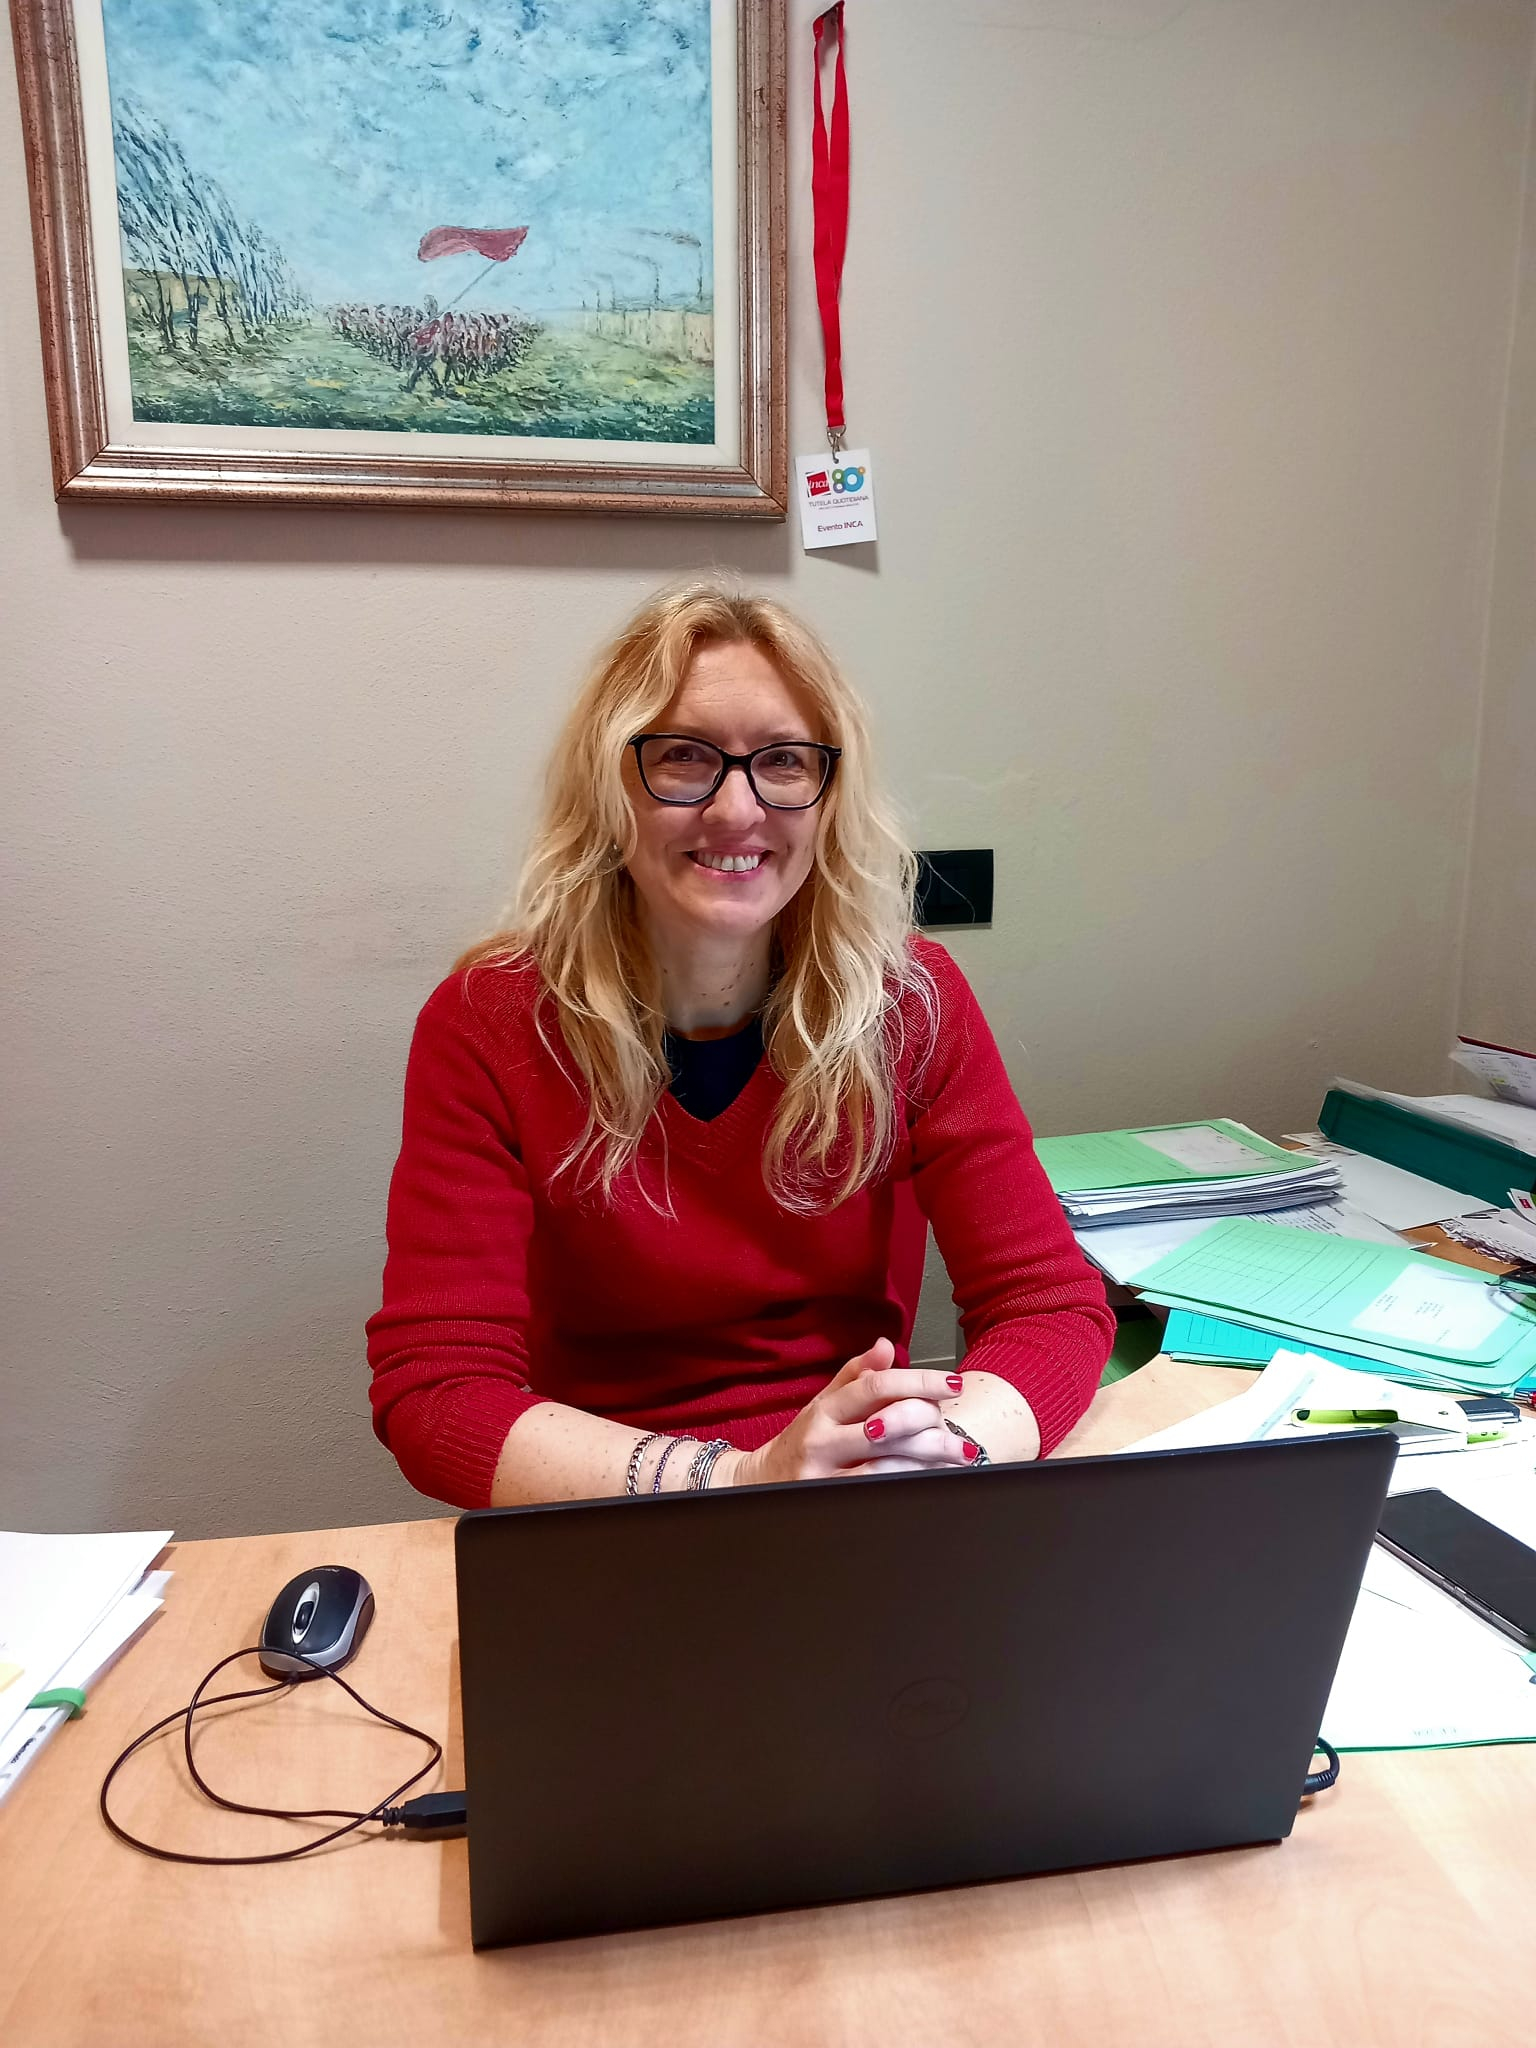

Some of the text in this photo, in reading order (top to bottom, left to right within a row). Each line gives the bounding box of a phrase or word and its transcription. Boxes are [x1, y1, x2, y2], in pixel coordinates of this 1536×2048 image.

[809, 500, 831, 508] TUTELA
[833, 496, 869, 505] QUOTIDIANA
[817, 520, 864, 533] Evento INCA
